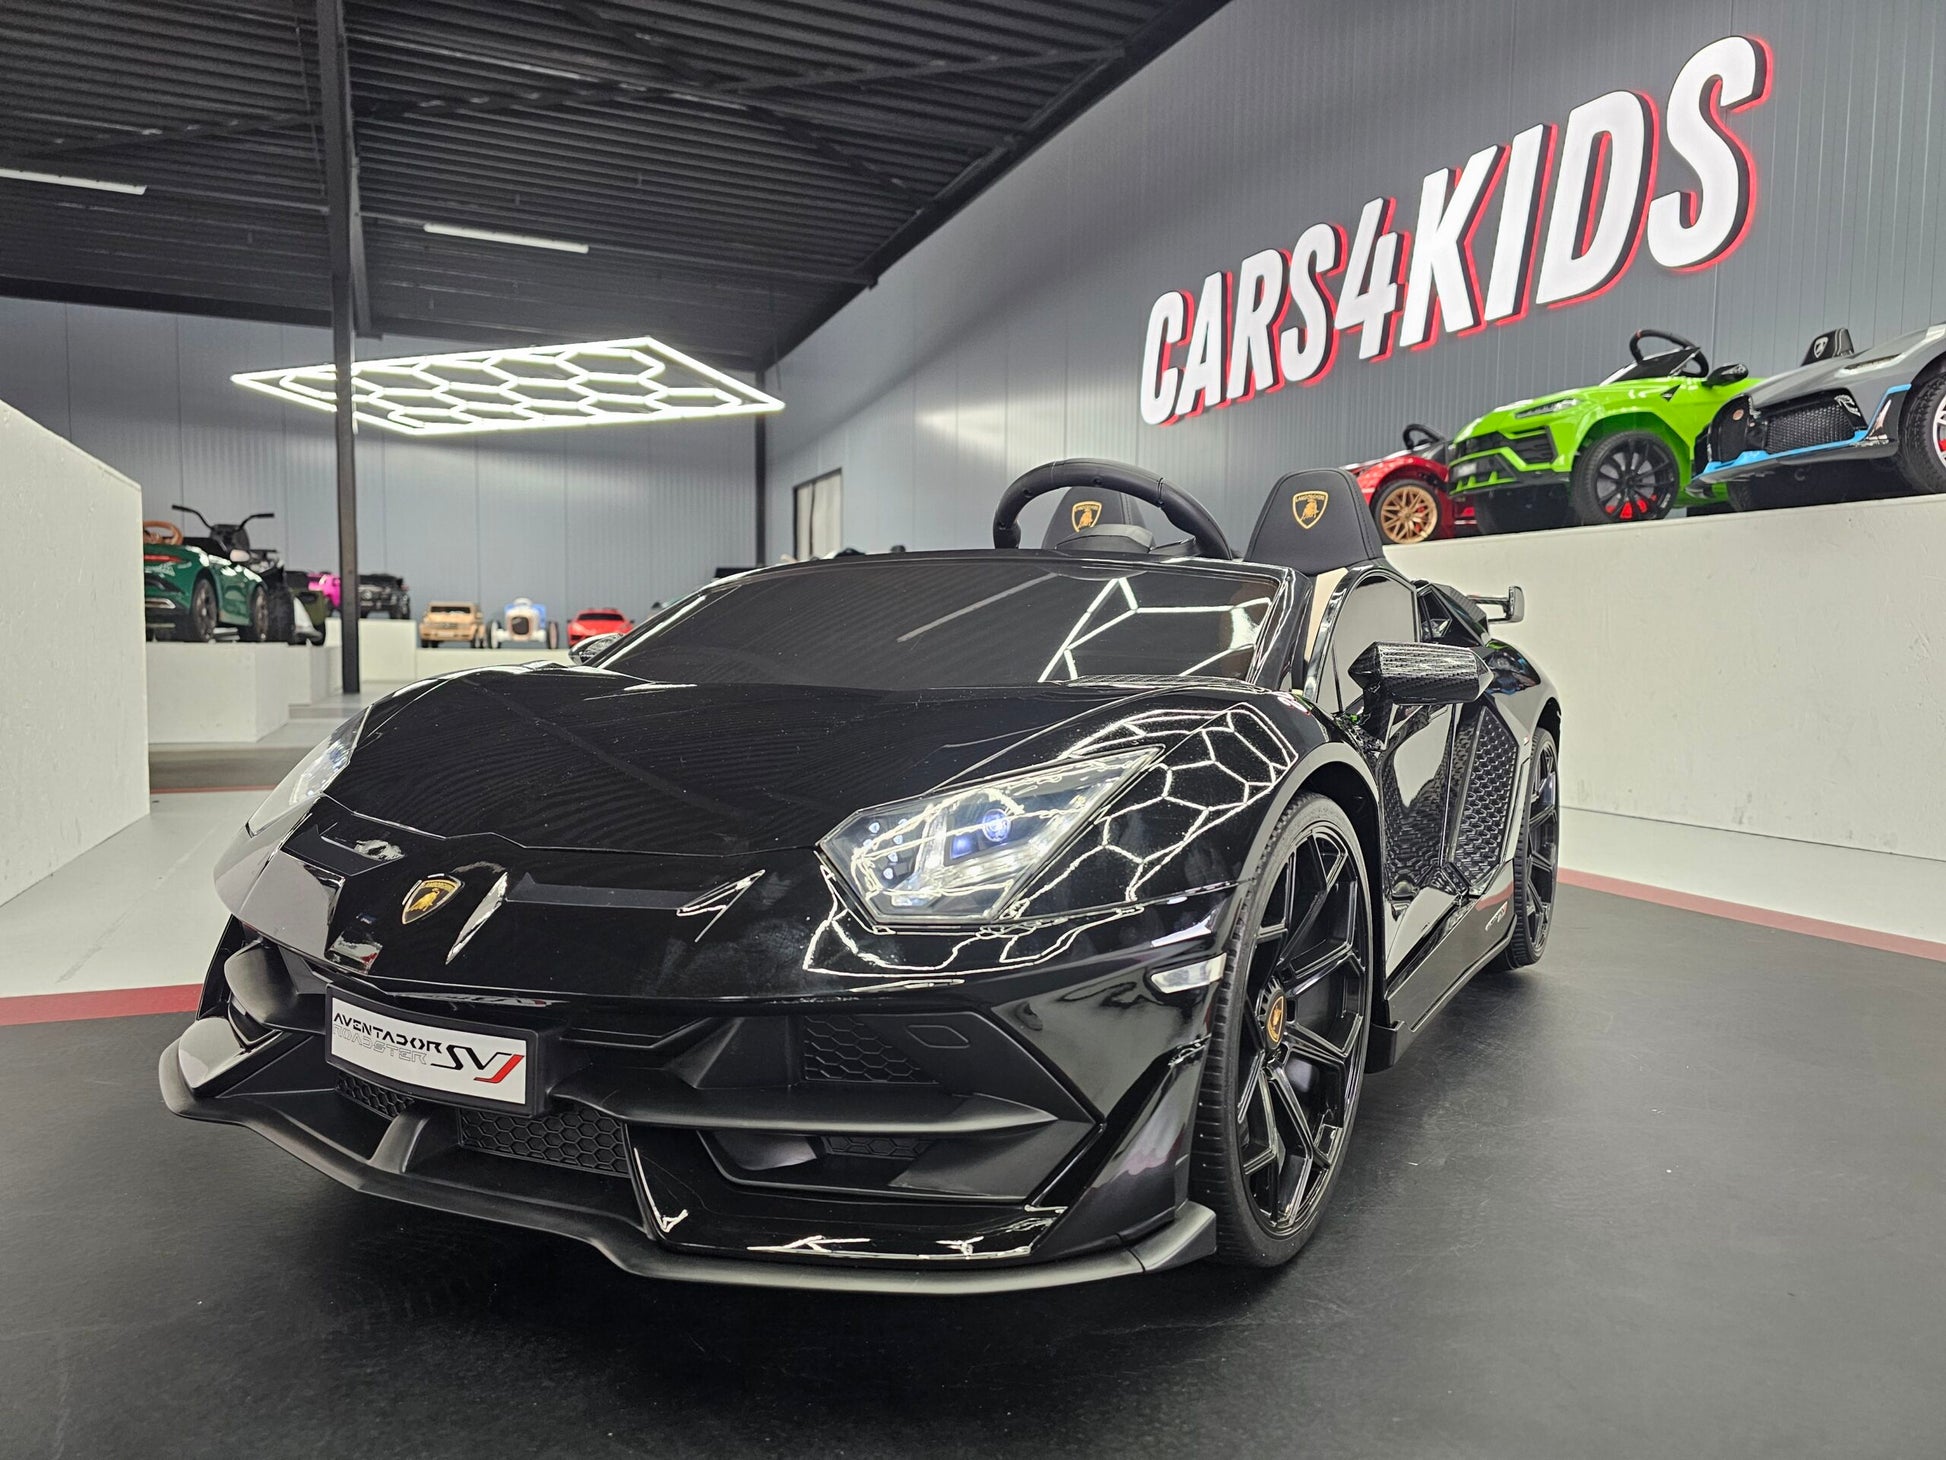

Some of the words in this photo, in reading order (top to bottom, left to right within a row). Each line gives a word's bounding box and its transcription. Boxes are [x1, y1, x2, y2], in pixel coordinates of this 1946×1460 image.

[1140, 35, 1770, 425] CARS4KIDS
[332, 1024, 427, 1065] ROADSTER
[333, 1012, 442, 1054] AVENTADOR
[430, 1045, 525, 1084] SVJ
